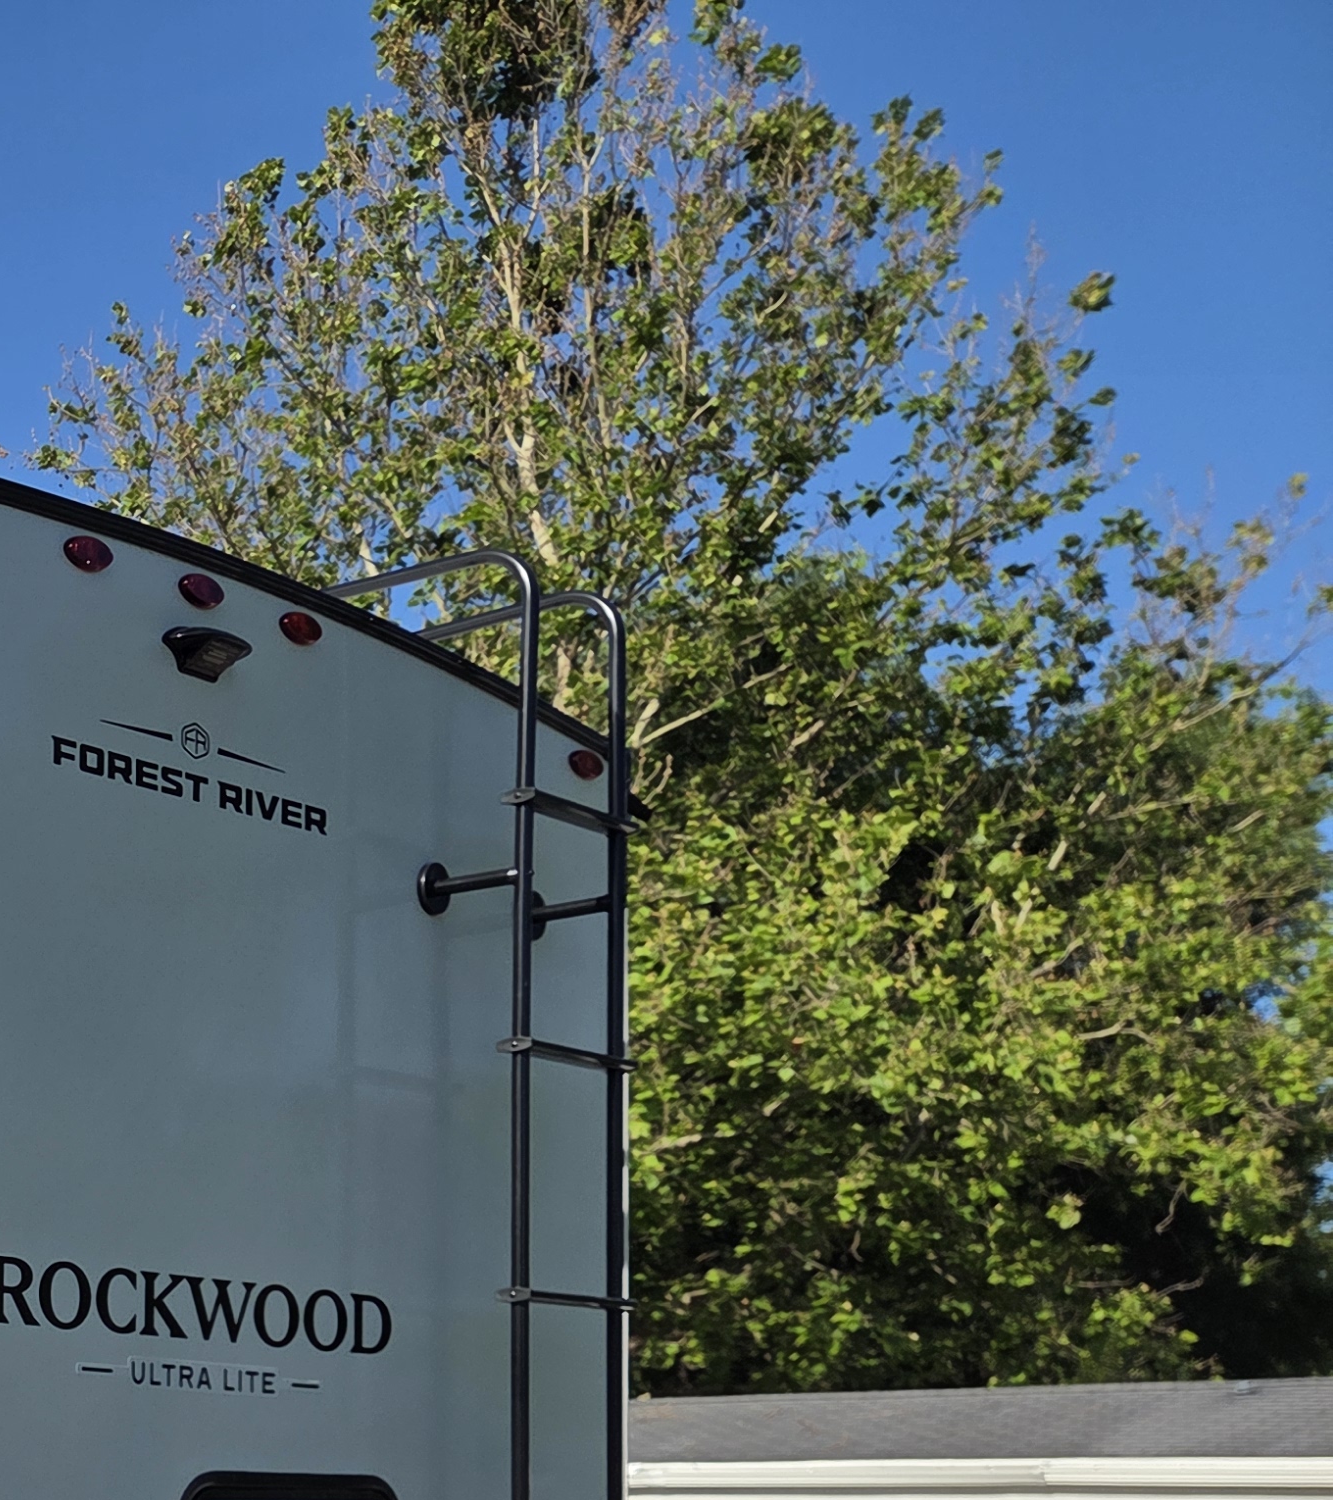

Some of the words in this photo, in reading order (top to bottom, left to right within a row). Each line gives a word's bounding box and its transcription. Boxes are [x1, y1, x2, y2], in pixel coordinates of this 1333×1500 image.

[51, 735, 208, 801] FOREST
[217, 780, 328, 836] RIVER
[130, 1360, 213, 1391] ULTRA
[222, 1367, 277, 1395] LITE
